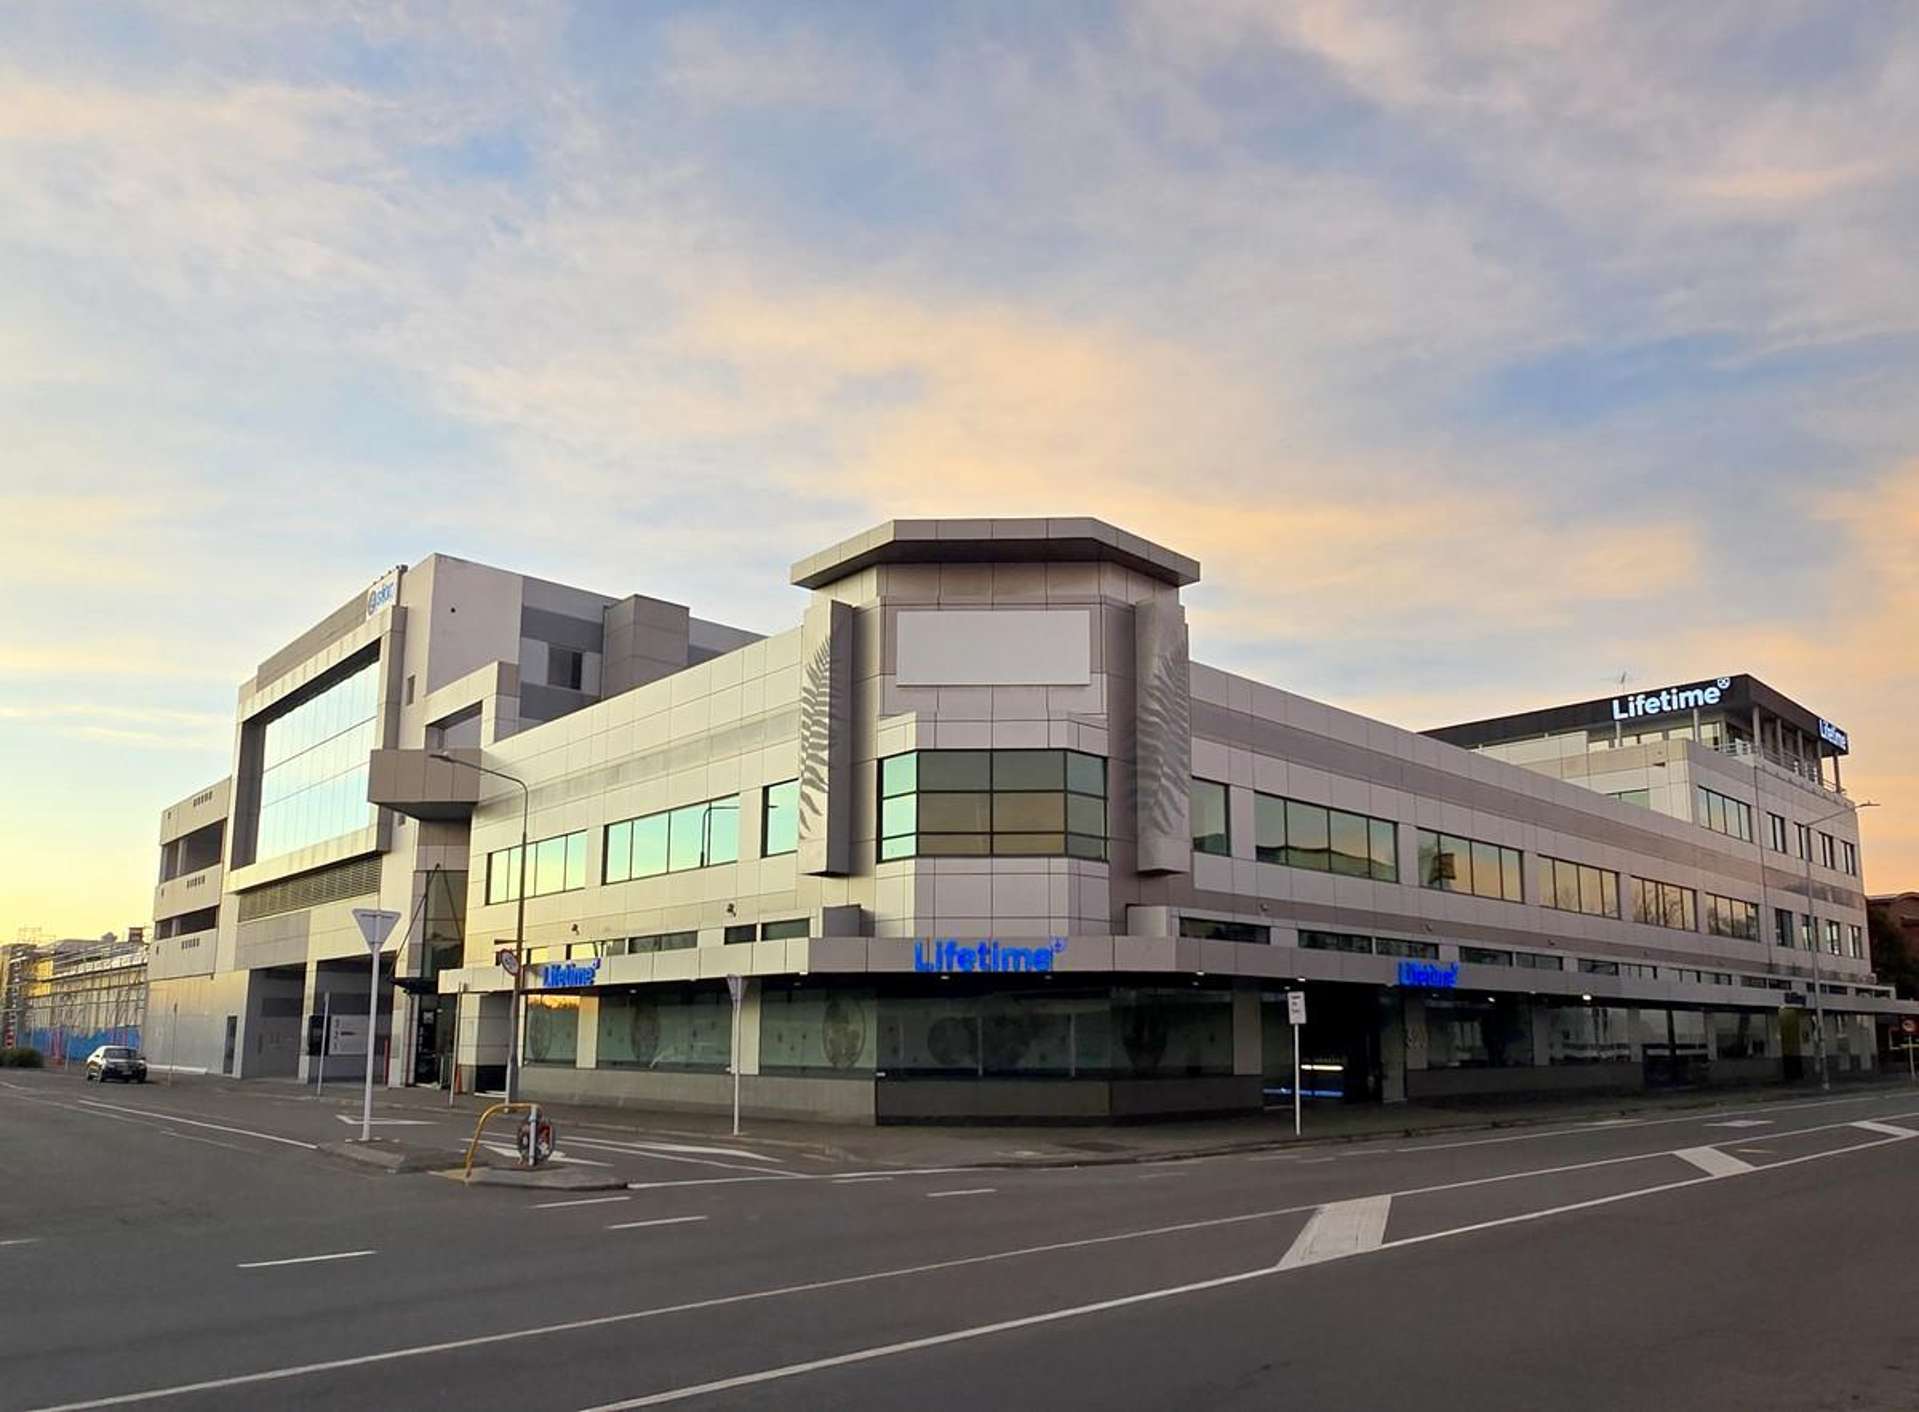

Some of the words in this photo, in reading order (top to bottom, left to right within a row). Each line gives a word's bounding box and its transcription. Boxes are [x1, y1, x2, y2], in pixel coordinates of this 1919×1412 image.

[1612, 686, 1721, 720] Lifetime
[1819, 719, 1846, 750] Lifetime
[915, 940, 1054, 972] Lifetime
[543, 963, 595, 988] Lifetime
